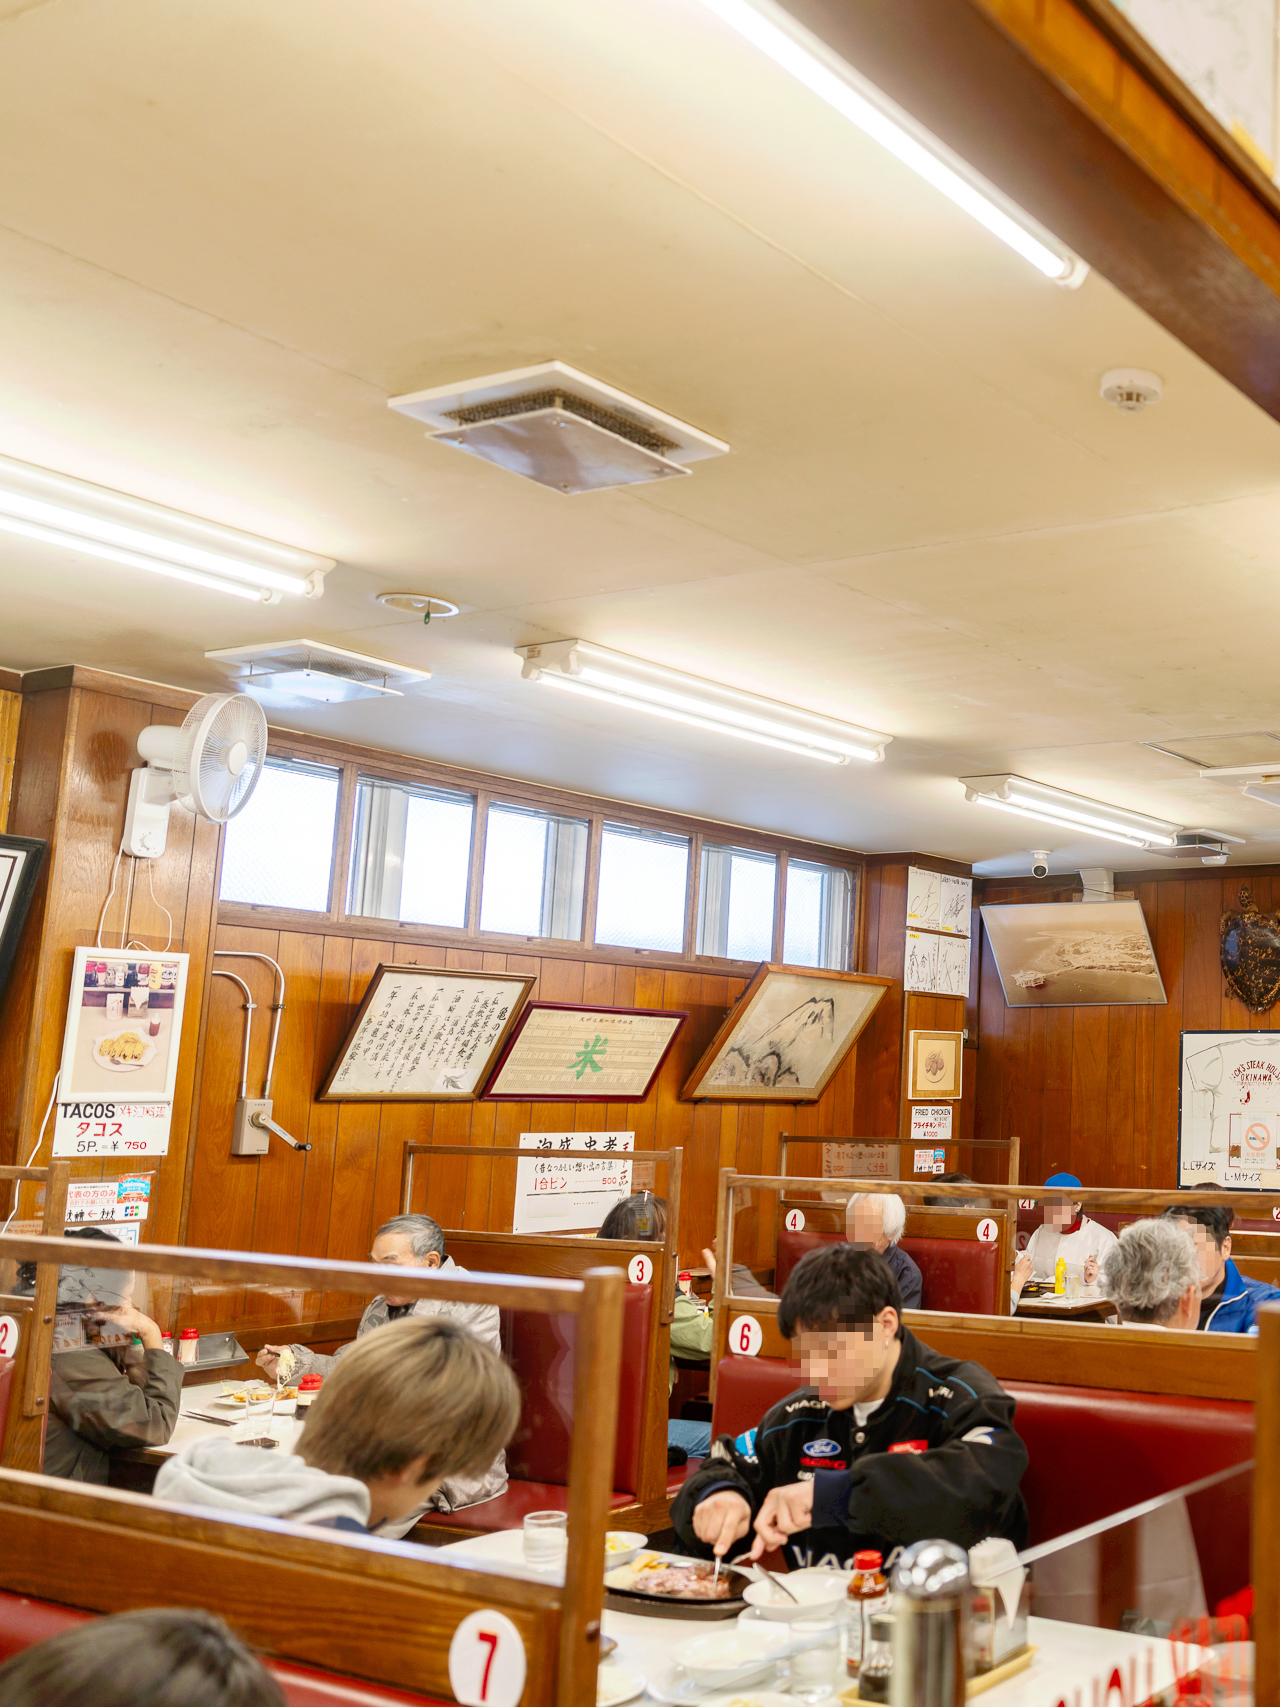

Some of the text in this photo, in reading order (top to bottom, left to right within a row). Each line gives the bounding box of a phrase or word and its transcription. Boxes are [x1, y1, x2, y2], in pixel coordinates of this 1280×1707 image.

[1247, 1060, 1265, 1070] STEAK
[62, 1103, 115, 1118] TACOS
[915, 1108, 928, 1116] FRIED
[76, 1122, 122, 1138] タコス
[125, 1141, 147, 1150] 750
[602, 1177, 617, 1185] 500
[790, 1214, 798, 1229] 4
[982, 1222, 990, 1240] 4
[636, 1260, 645, 1282] 3
[739, 1323, 751, 1352] 6
[477, 1630, 498, 1702] 7
